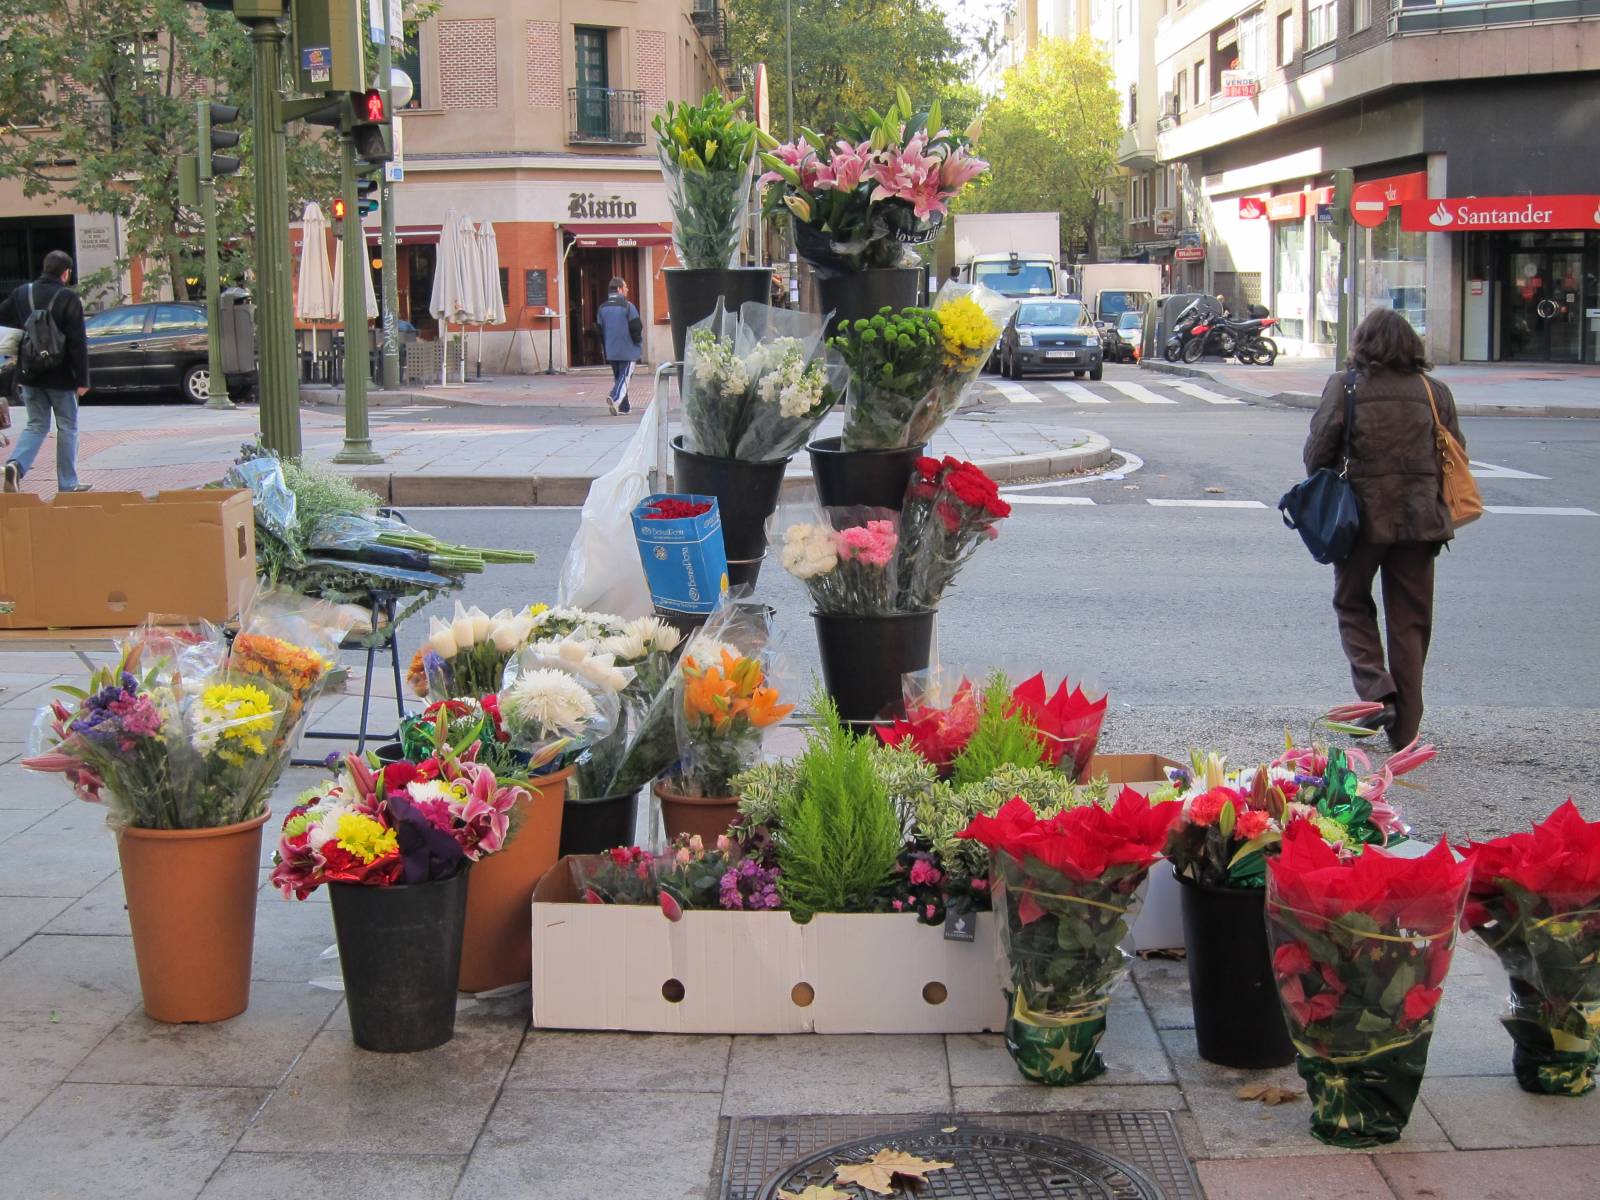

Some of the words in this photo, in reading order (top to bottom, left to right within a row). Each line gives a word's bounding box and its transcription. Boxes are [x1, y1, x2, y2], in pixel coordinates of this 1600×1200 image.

[568, 192, 637, 219] Riaño
[1457, 203, 1553, 226] Santander
[896, 228, 921, 242] love
